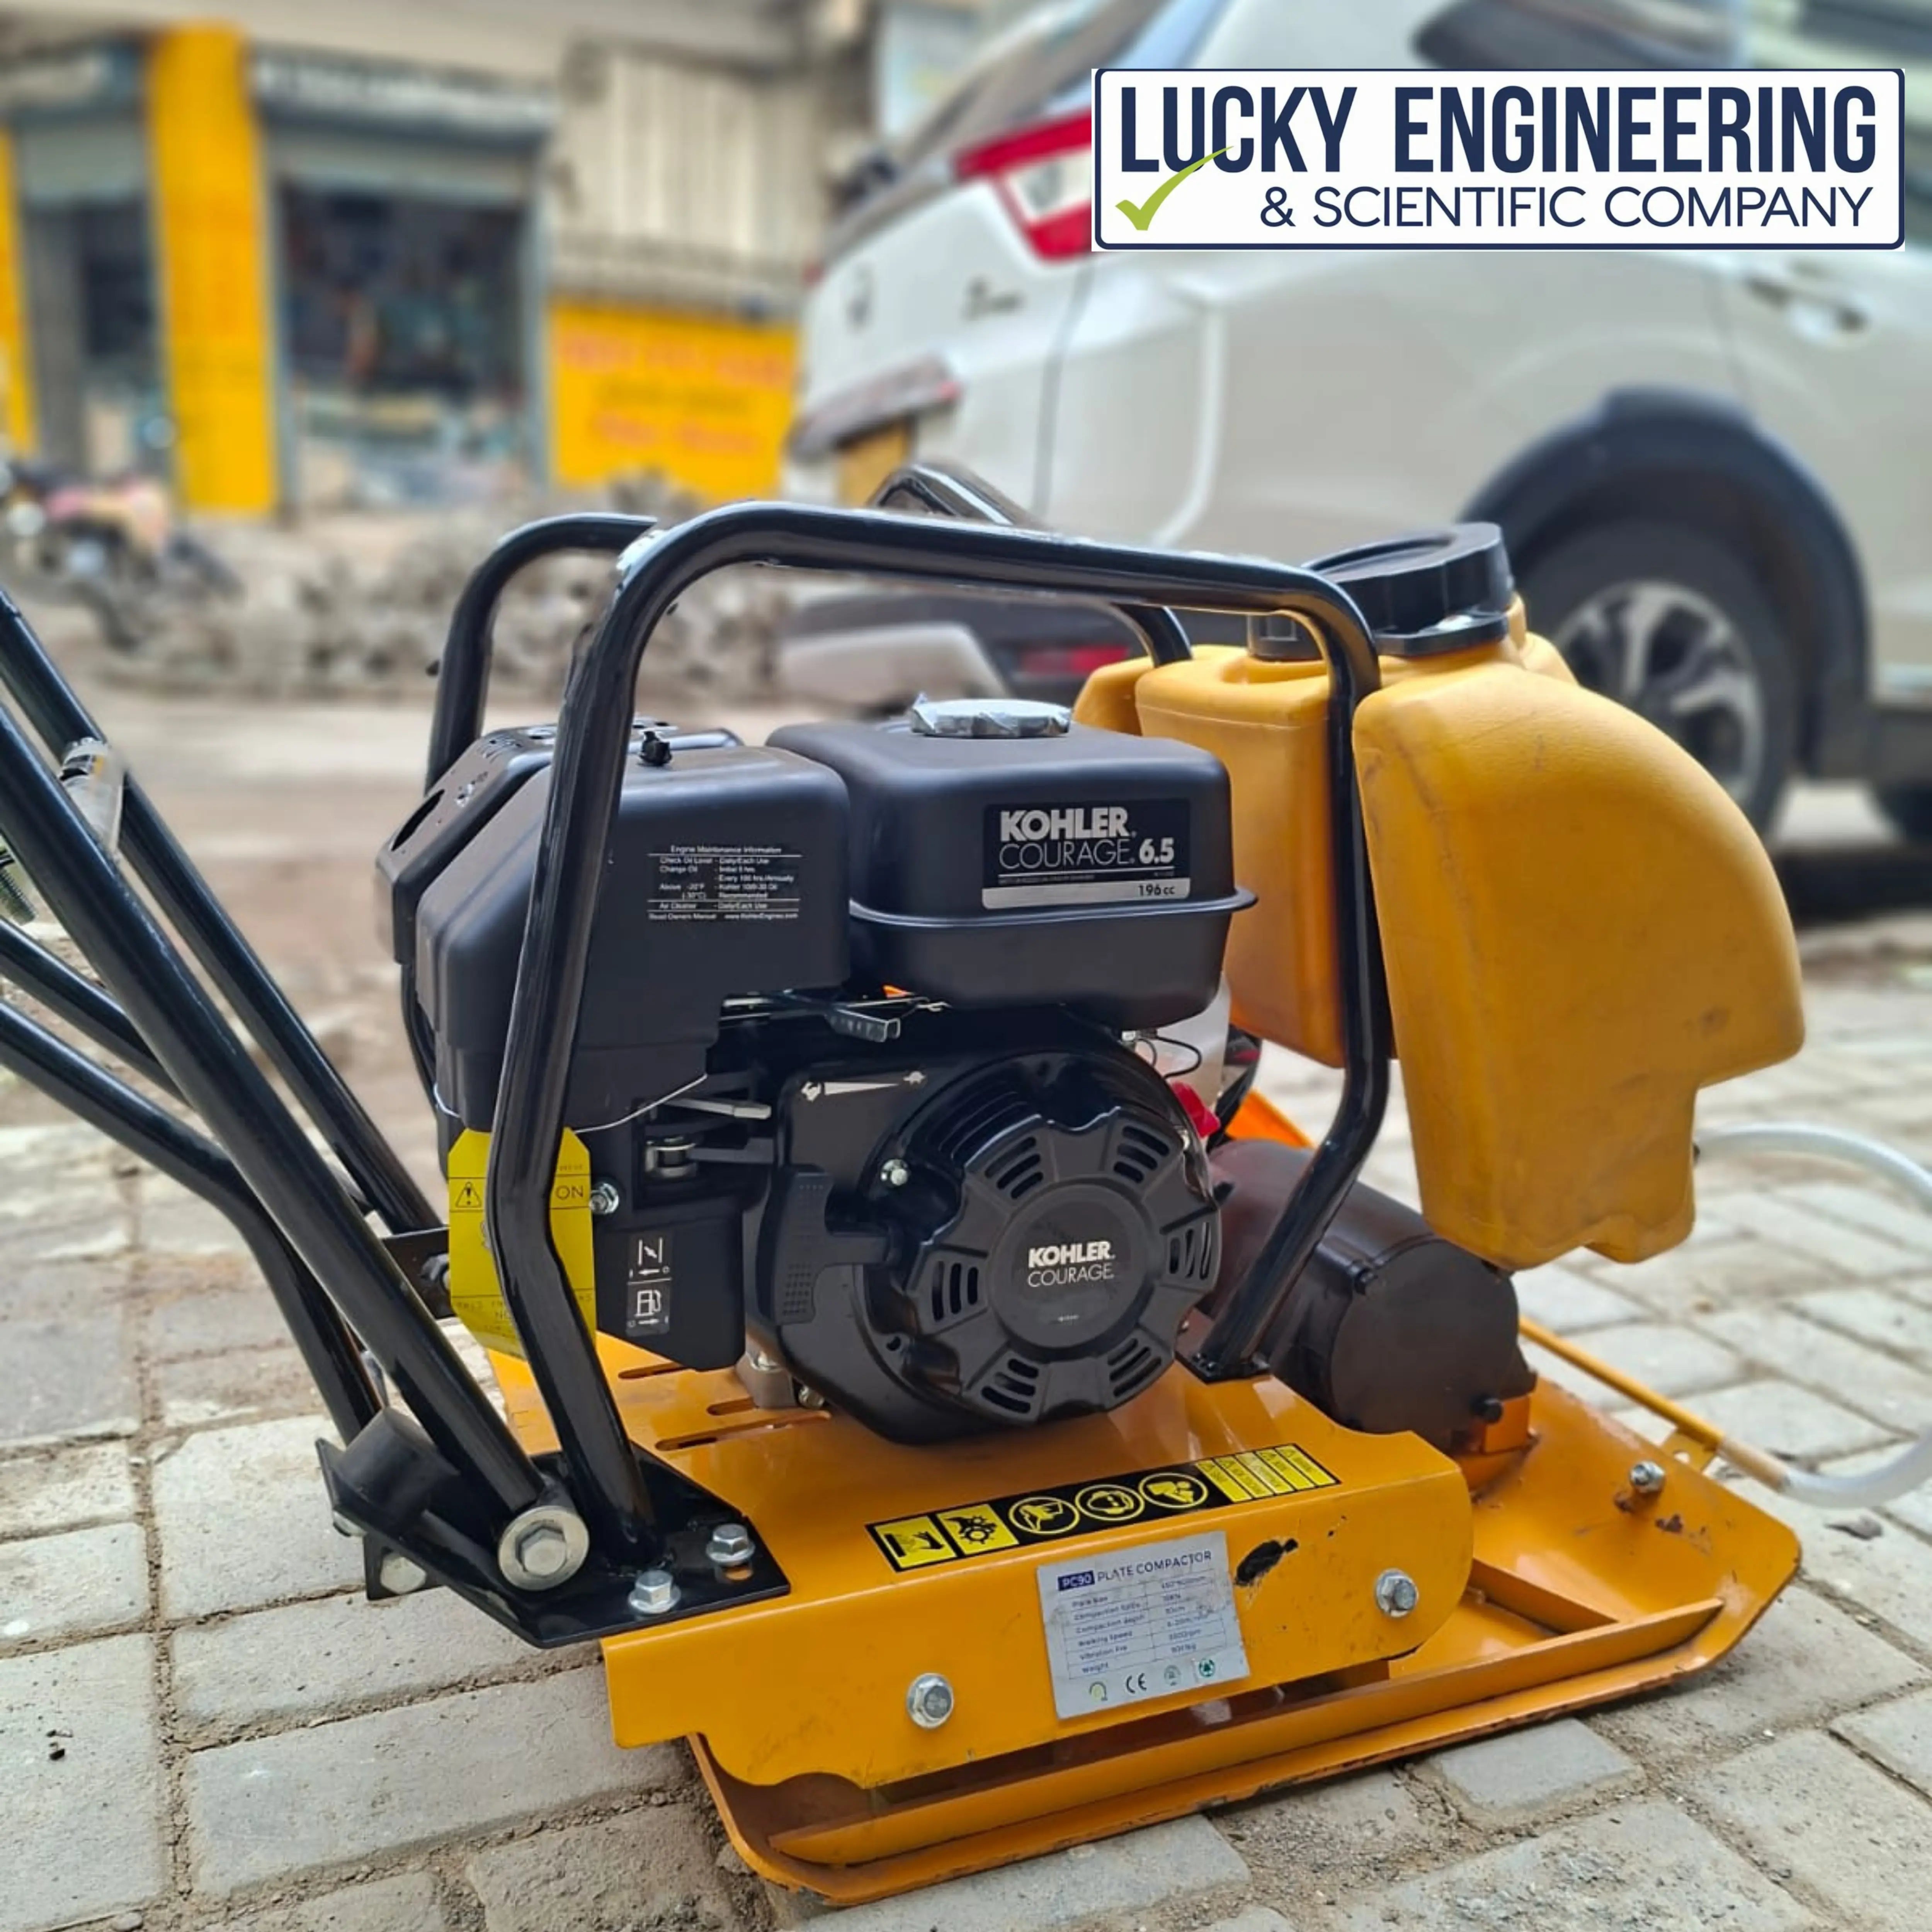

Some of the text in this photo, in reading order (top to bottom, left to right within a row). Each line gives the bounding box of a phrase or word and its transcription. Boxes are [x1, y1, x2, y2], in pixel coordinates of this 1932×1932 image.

[1000, 807, 1129, 842] KOHLER
[671, 845, 695, 855] Engine
[999, 837, 1174, 869] COURAGE 6.5
[1028, 1240, 1111, 1268] KOHLER
[1027, 1262, 1114, 1287] COURAGE
[1097, 1566, 1134, 1582] PLATE
[1136, 1550, 1212, 1575] COMPACTOR
